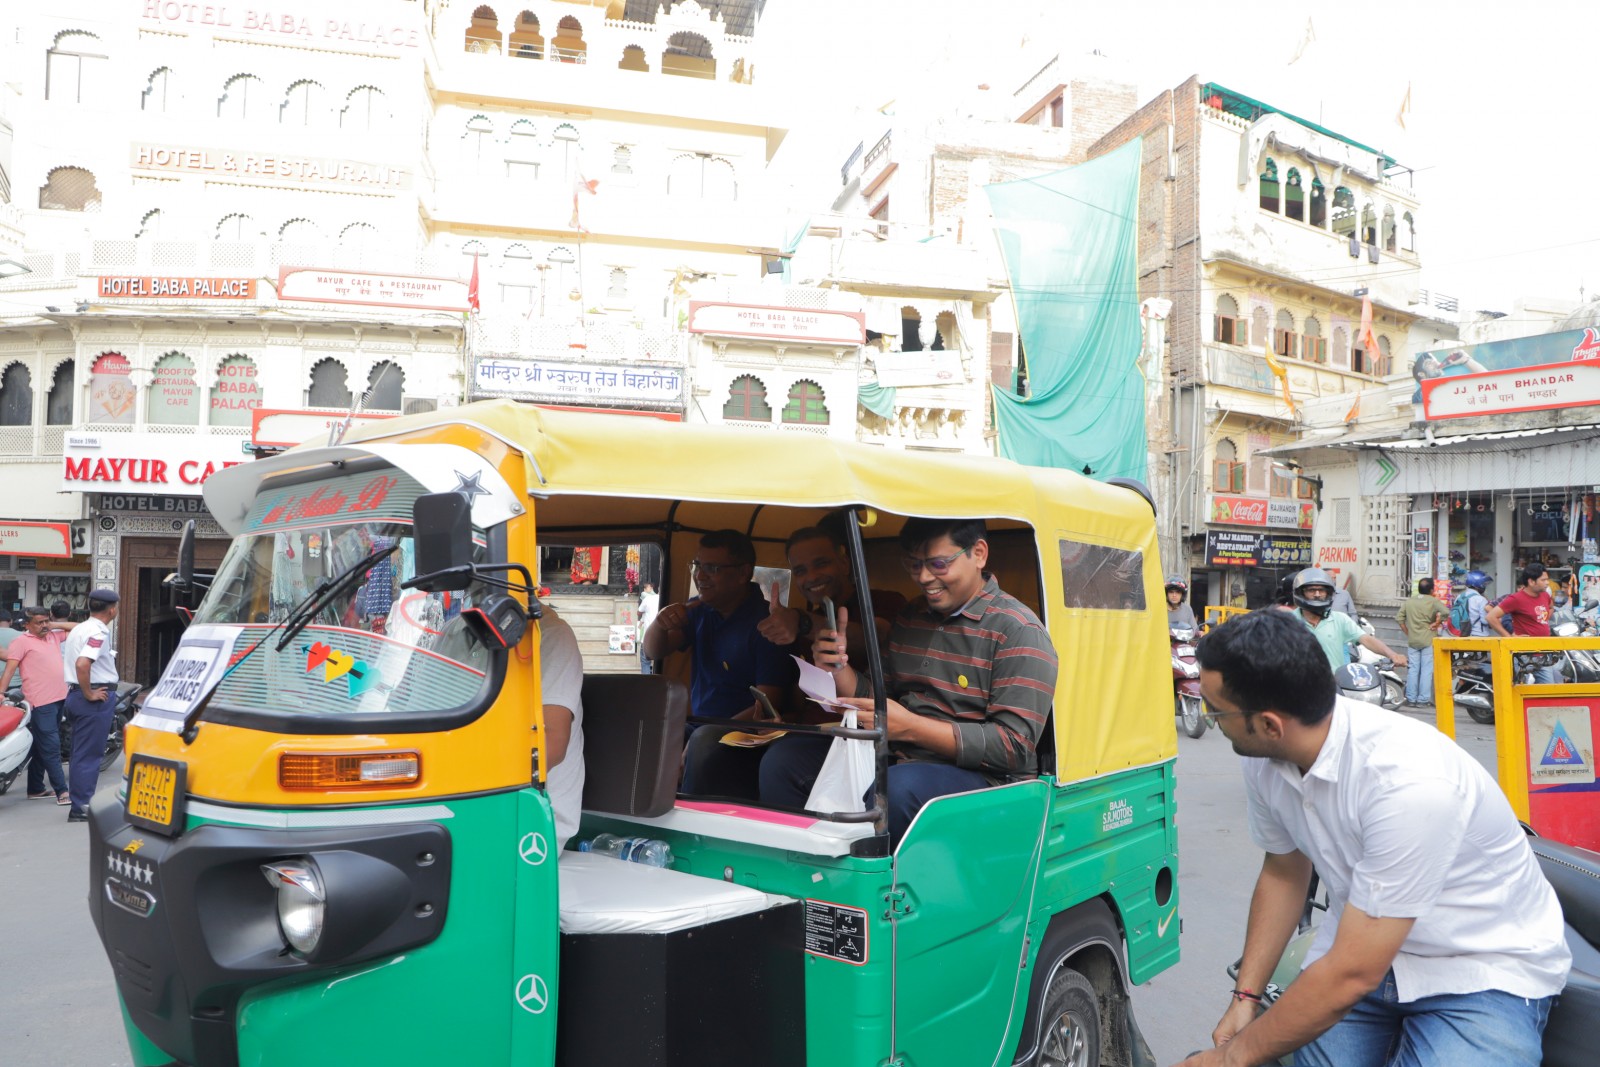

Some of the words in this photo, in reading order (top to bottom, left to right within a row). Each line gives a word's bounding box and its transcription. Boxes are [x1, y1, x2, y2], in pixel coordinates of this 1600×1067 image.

[142, 0, 232, 26] HOTEL
[243, 9, 313, 37] BABA
[324, 18, 419, 48] PALACE
[138, 146, 215, 170] HOTEL
[223, 153, 238, 172] &
[243, 156, 405, 187] RESTAURANT
[102, 278, 148, 295] HOTEL
[151, 278, 189, 296] BABA
[194, 279, 249, 297] PALACE
[317, 276, 344, 285] MAYUR
[351, 278, 371, 287] CAFE
[391, 281, 442, 291] RESTAURANT
[738, 312, 761, 320] HOTEL
[792, 315, 819, 324] PALACE
[102, 360, 131, 370] Havm
[157, 368, 181, 376] ROOF
[525, 363, 542, 382] श्री
[596, 368, 618, 388] तेज
[1477, 383, 1498, 392] PAN
[1515, 374, 1575, 388] BHANDAR
[163, 388, 192, 396] MAYUR
[219, 381, 257, 393] BABA
[167, 398, 188, 406] CAFE
[70, 437, 83, 445] Since
[65, 457, 168, 483] MAYUR
[178, 460, 250, 485] CA
[102, 496, 159, 511] HOTEL
[1268, 515, 1297, 524] RESTAURANT
[1216, 543, 1254, 551] RESTAURANT
[1318, 546, 1357, 563] PARKING
[170, 681, 201, 702] RACE
